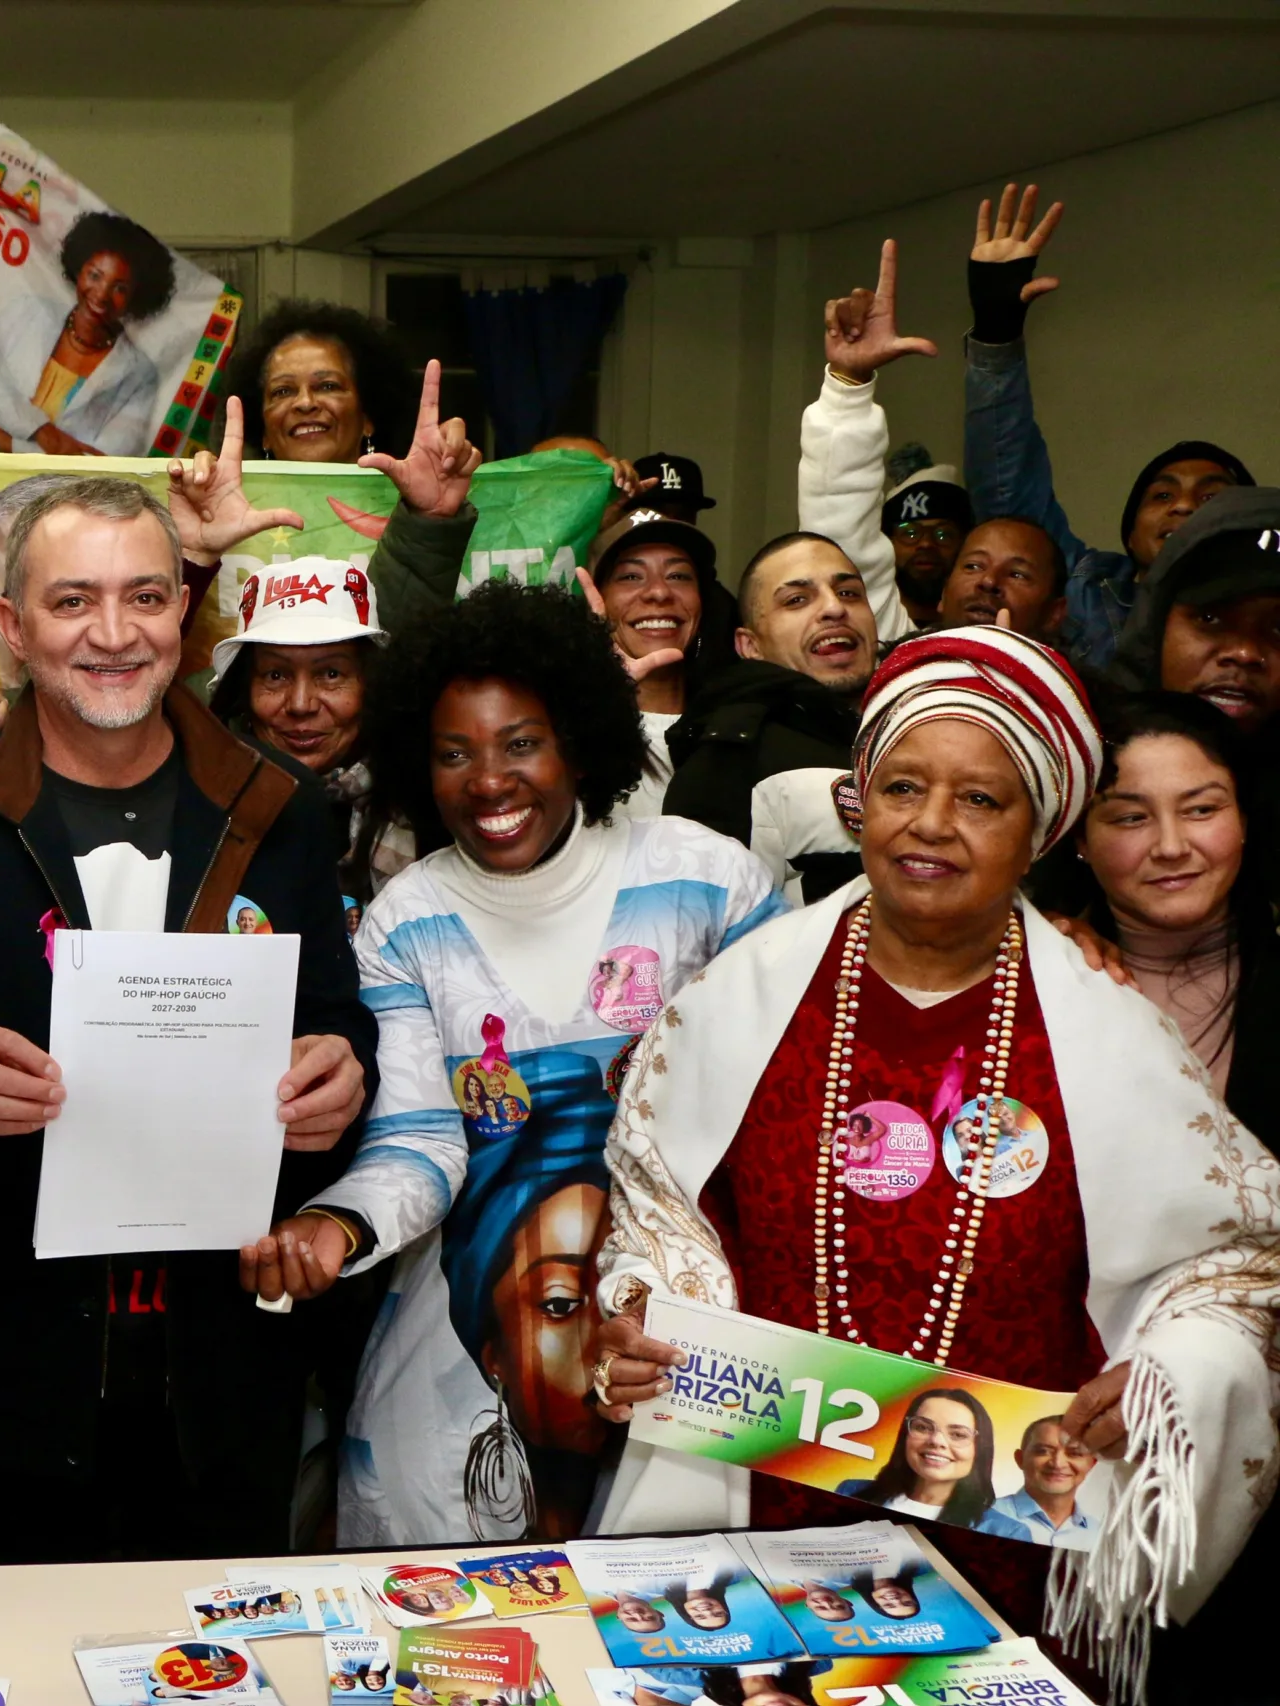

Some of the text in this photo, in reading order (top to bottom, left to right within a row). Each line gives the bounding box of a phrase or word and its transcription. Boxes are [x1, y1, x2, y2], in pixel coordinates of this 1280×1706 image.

[660, 463, 682, 489] LA
[901, 492, 929, 520] NY
[347, 573, 359, 584] 131
[263, 573, 335, 608] LULA
[278, 598, 296, 609] 13
[646, 962, 659, 972] TOC
[118, 976, 232, 986] AGENDA ESTRATÉGICA
[636, 974, 659, 986] GUR
[123, 990, 226, 1000] DO HIP-HOP GAÚCHO
[152, 1004, 197, 1013] 2027-2030
[460, 1063, 510, 1078] TIME ULA
[891, 1123, 900, 1134] TE
[888, 1135, 928, 1149] GURIA!
[1012, 1148, 1040, 1172] 12
[887, 1173, 917, 1187] 1350
[670, 1338, 780, 1374] GOVERNADORA
[675, 1354, 785, 1400] ULIANA
[670, 1397, 723, 1417] EDEGAR
[729, 1412, 781, 1433] PRETTO
[790, 1376, 881, 1460] 12
[389, 1578, 418, 1590] 131
[211, 1588, 272, 1601] JULIANA 12
[509, 1591, 569, 1606] TIME DO LULA
[824, 1625, 945, 1647] JULIANA 12
[872, 1623, 944, 1636] BRIZOLA
[634, 1637, 753, 1658] JULIANA 12
[680, 1634, 752, 1647] BRIZOLA
[408, 1645, 510, 1664] Porto Alegre
[160, 1658, 213, 1688] 13
[411, 1661, 504, 1683] PIMENTA 131
[915, 1673, 1028, 1688] EDEGAR PRETTO
[921, 1680, 1060, 1703] BRIZOLA
